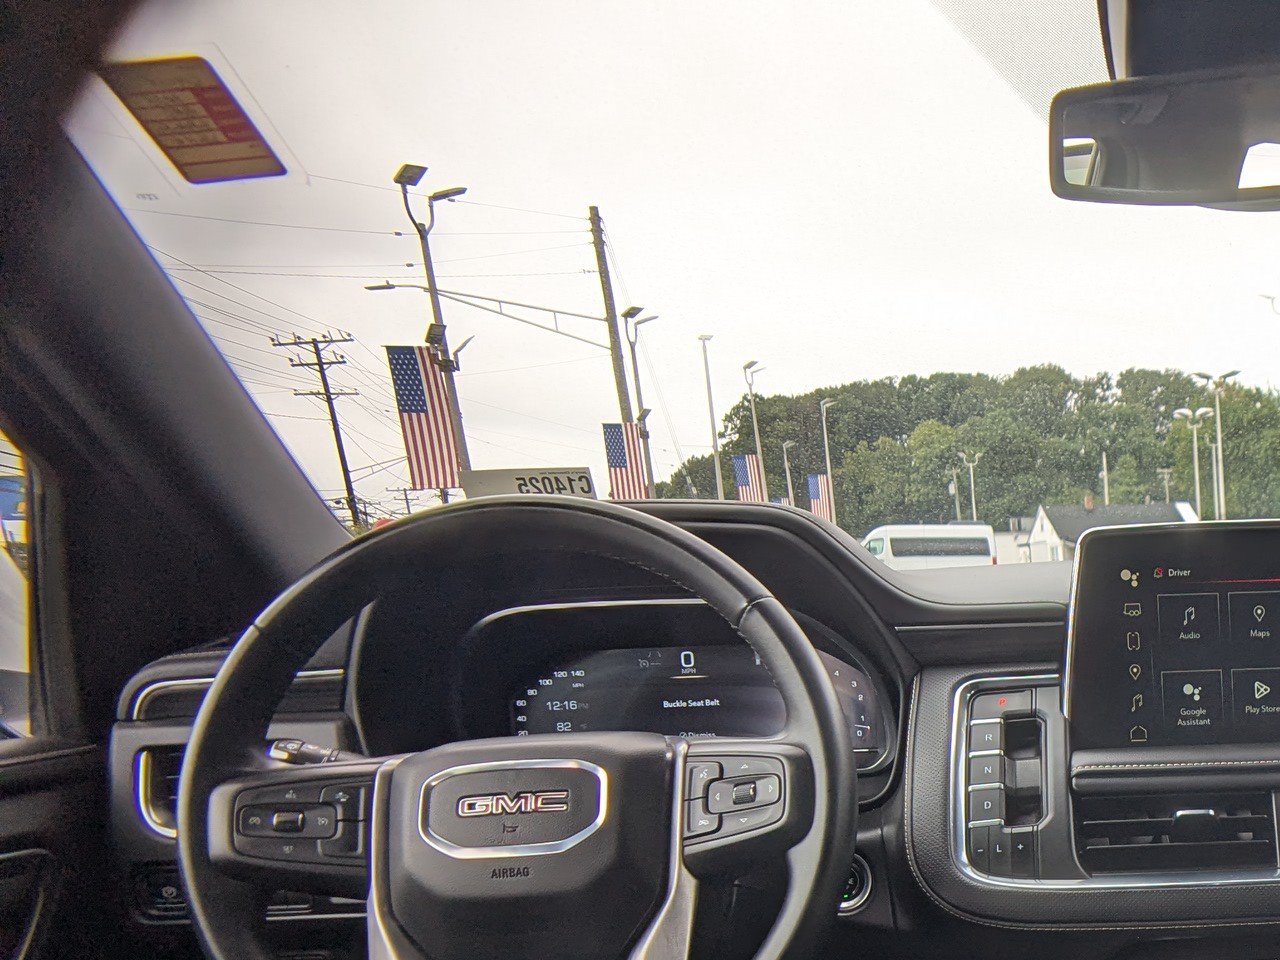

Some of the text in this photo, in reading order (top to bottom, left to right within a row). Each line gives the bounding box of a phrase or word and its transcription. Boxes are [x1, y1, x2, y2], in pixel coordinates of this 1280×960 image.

[1168, 568, 1191, 577] Driver
[1179, 631, 1201, 639] Audio
[1250, 629, 1271, 639] Maps
[680, 650, 695, 668] 0
[546, 701, 578, 711] 12:16
[663, 698, 720, 708] Buckle Seat Belt
[1180, 707, 1207, 717] Google
[1245, 704, 1280, 714] Play Store
[556, 722, 572, 732] 82
[1177, 718, 1211, 726] Assistant
[985, 733, 993, 741] R
[984, 766, 992, 774] N
[458, 791, 568, 817] GMC
[983, 801, 992, 810] D
[996, 845, 1002, 853] L
[490, 866, 530, 880] AIRBAG
